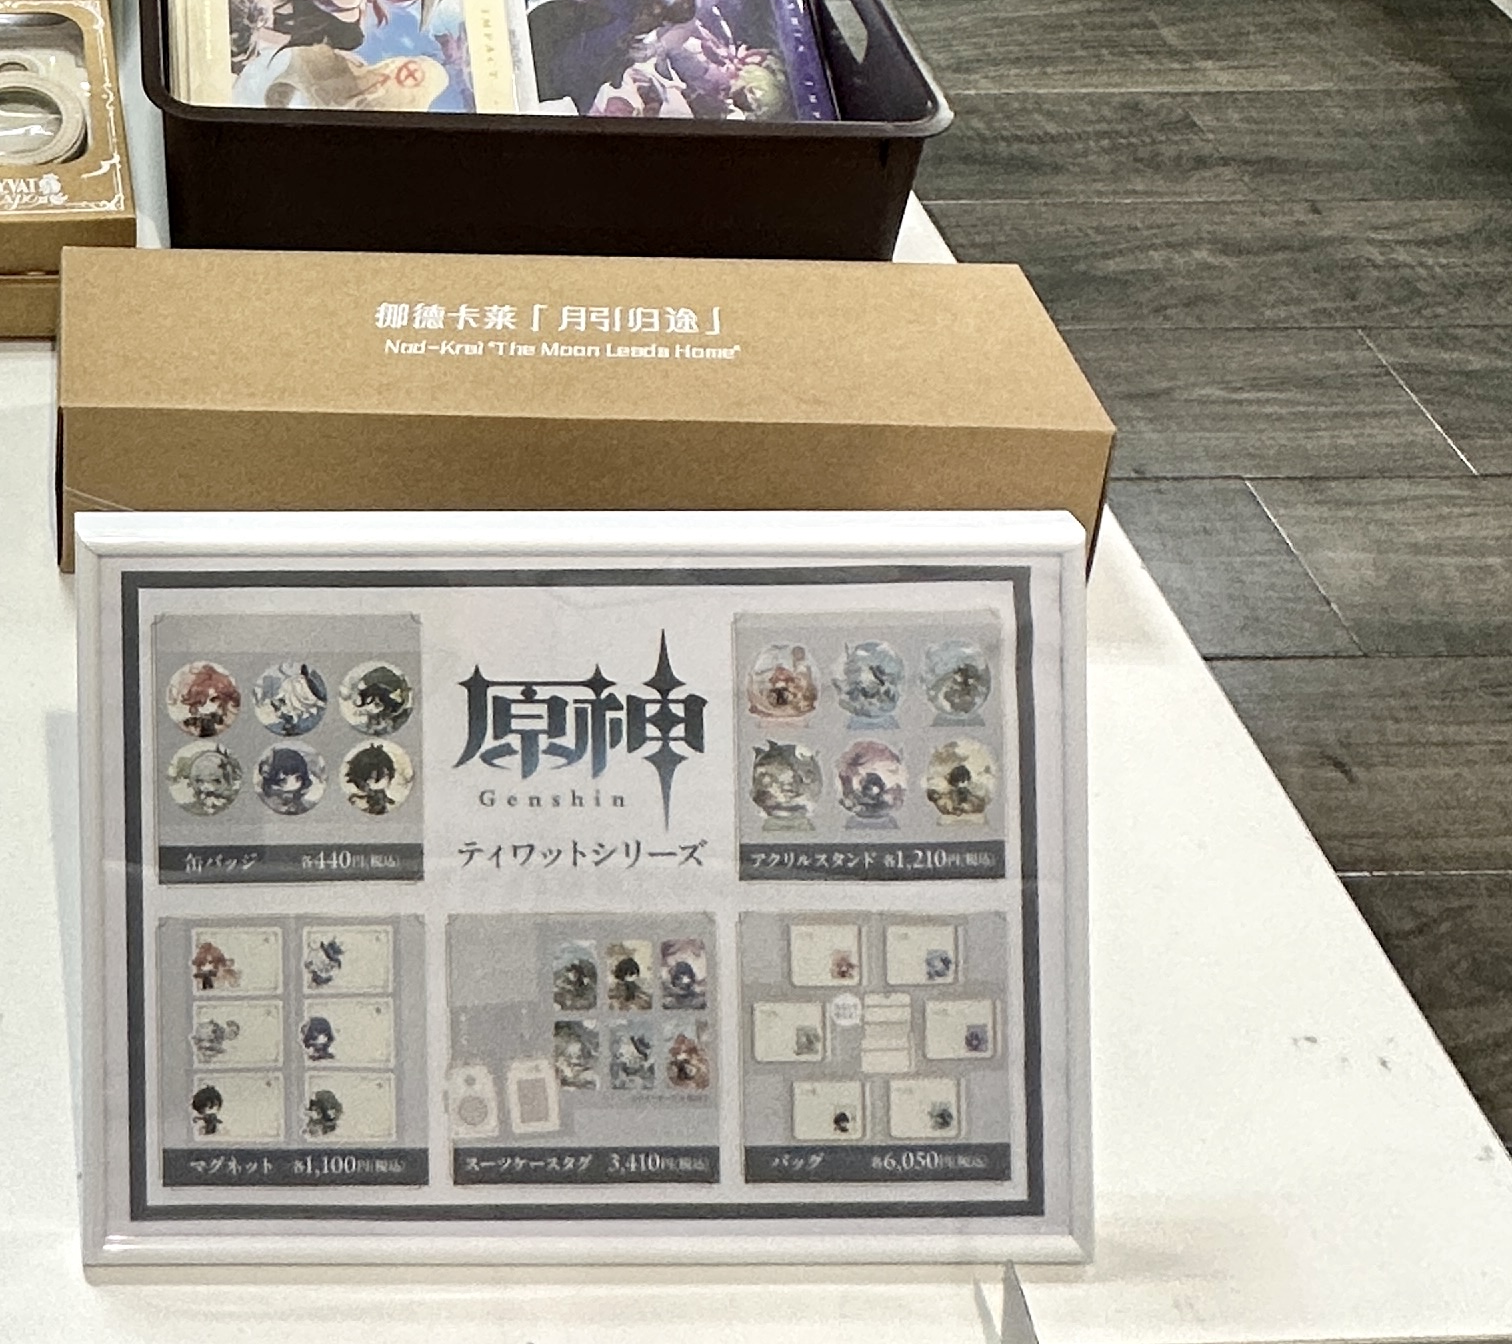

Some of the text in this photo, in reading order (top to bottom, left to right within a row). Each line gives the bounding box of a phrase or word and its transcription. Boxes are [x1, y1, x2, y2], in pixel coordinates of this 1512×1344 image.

[540, 342, 600, 358] Moon
[605, 343, 670, 359] Leads
[451, 627, 709, 833] 原神
[478, 787, 627, 809] Genshin
[457, 838, 709, 870] ティワットシリーズ
[749, 849, 875, 868] アクリルスタンド
[188, 1159, 274, 1175] マグネット
[464, 1154, 593, 1173] スーツケースタグ
